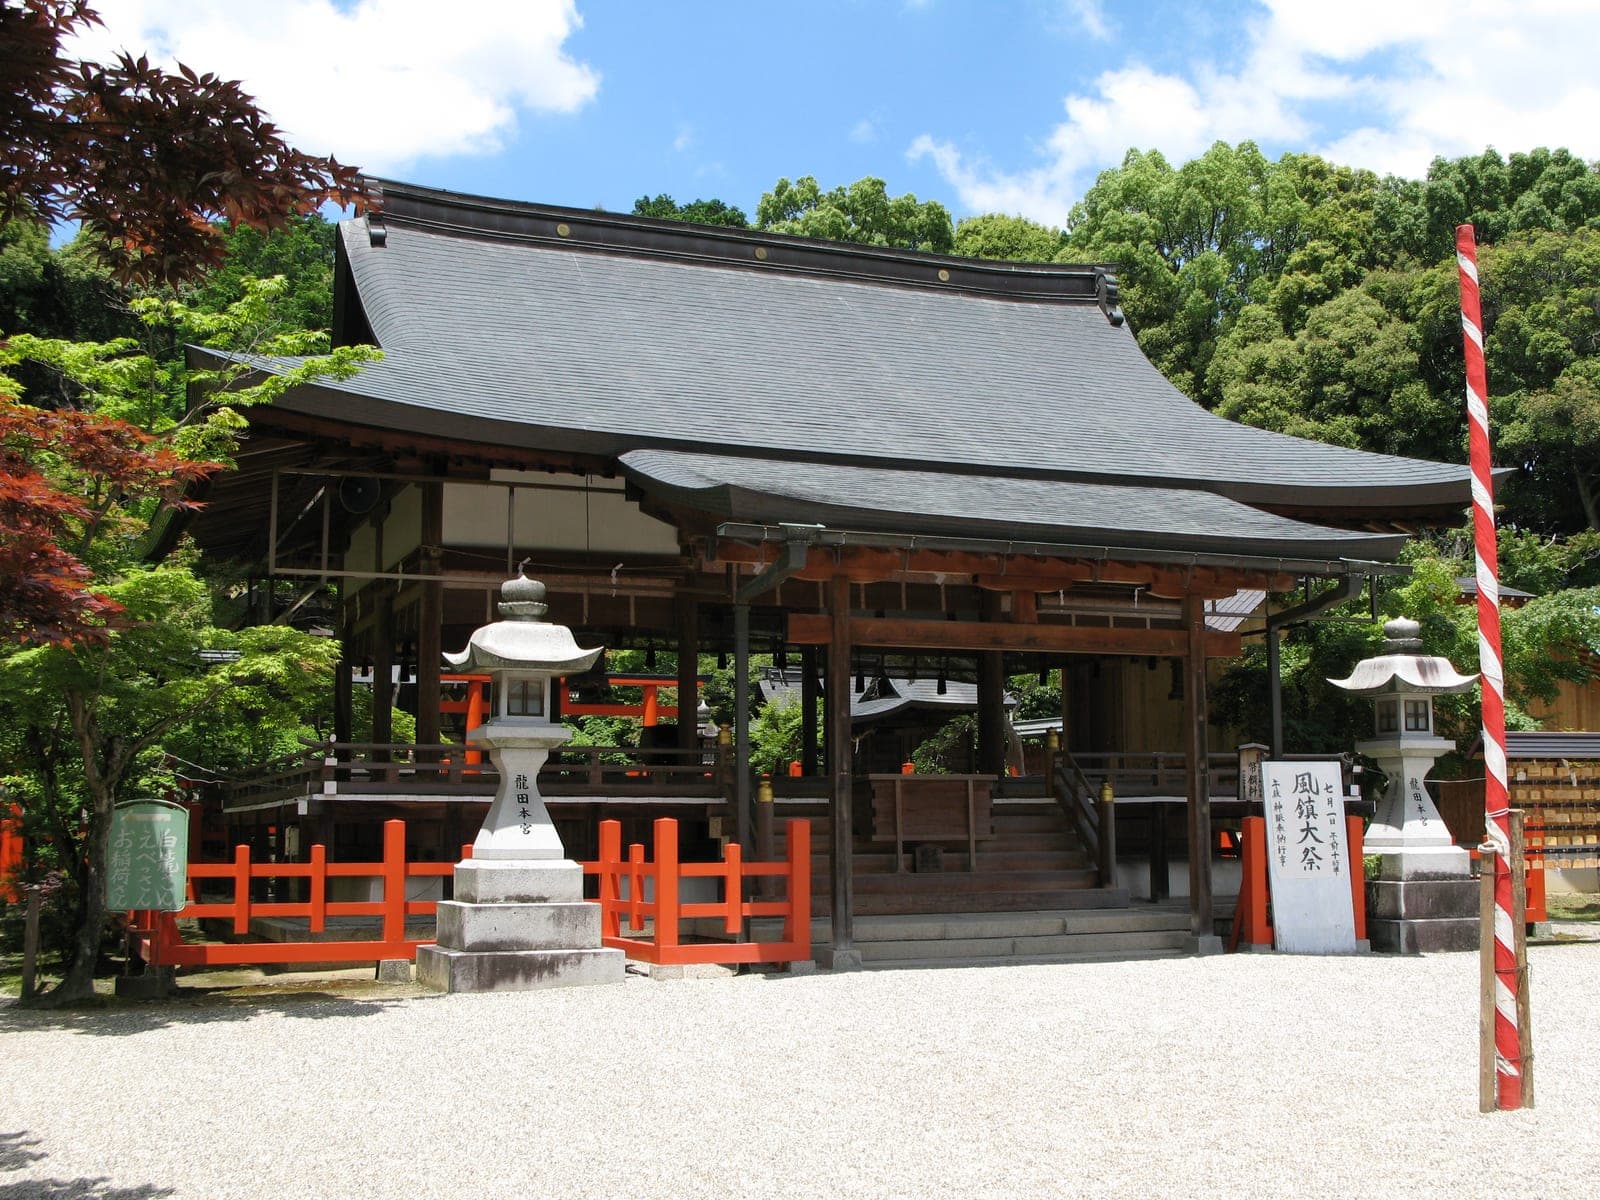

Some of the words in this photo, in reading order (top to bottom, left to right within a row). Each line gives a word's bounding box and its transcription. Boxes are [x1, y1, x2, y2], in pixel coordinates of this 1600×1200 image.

[514, 774, 532, 835] 龍田本宮
[1293, 772, 1325, 872] 風鎮大祭
[1410, 777, 1428, 826] 龍田本宮
[136, 826, 157, 906] えべっさん
